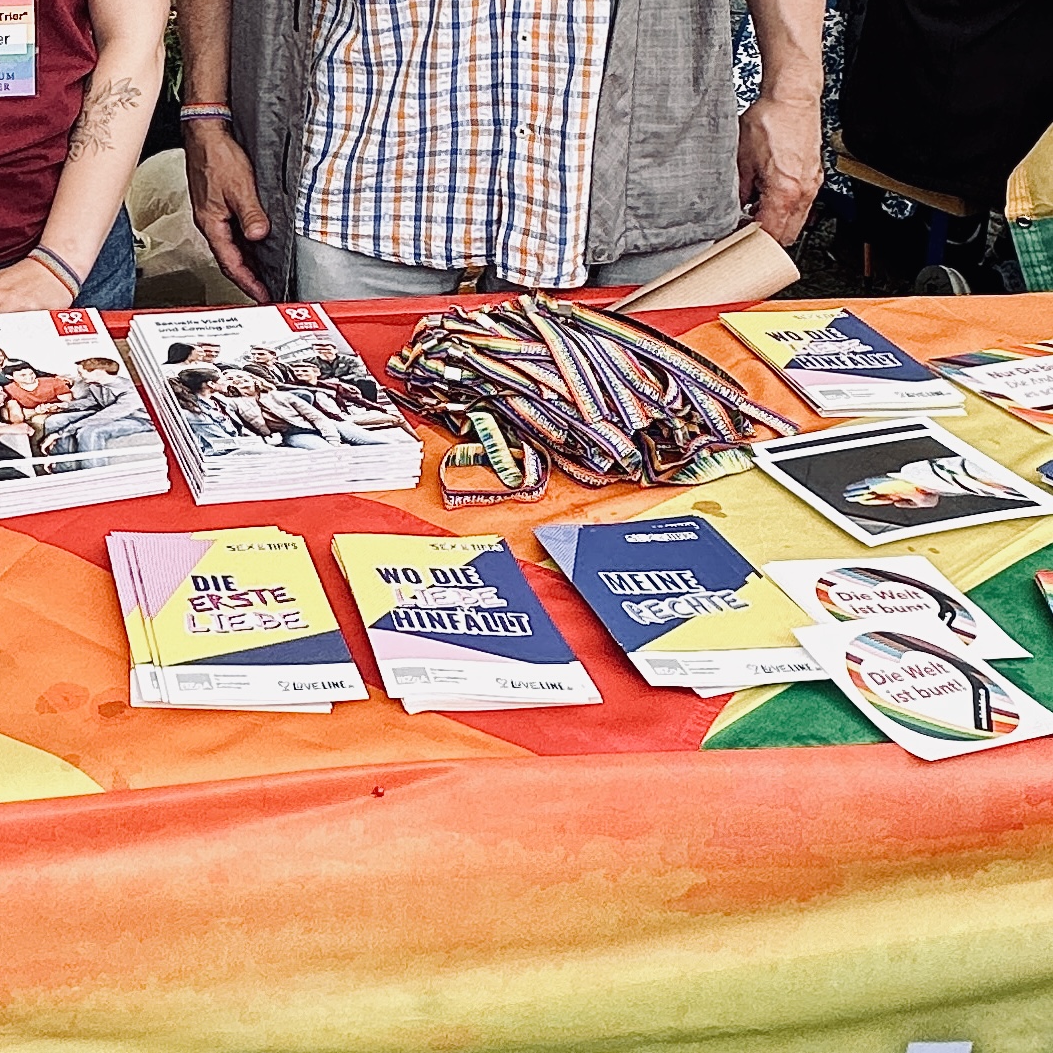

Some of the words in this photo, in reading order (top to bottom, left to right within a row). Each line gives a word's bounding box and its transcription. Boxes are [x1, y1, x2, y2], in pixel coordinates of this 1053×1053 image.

[765, 330, 804, 342] WO
[191, 575, 238, 592] DIE
[375, 567, 423, 585] WO
[431, 566, 482, 586] DIE
[601, 571, 701, 594] MEINE
[188, 587, 296, 613] ERSTE
[395, 587, 506, 608] LIEBE
[624, 591, 748, 622] RECHTE
[835, 590, 873, 602] Die
[874, 589, 924, 600] Welt
[850, 604, 876, 614] ist
[187, 612, 309, 634] LIEBE
[396, 607, 532, 635] HINFÄLLT
[867, 668, 905, 686] Die
[901, 661, 951, 680] Welt
[886, 690, 914, 704] ist
[916, 678, 968, 700] bunt!
